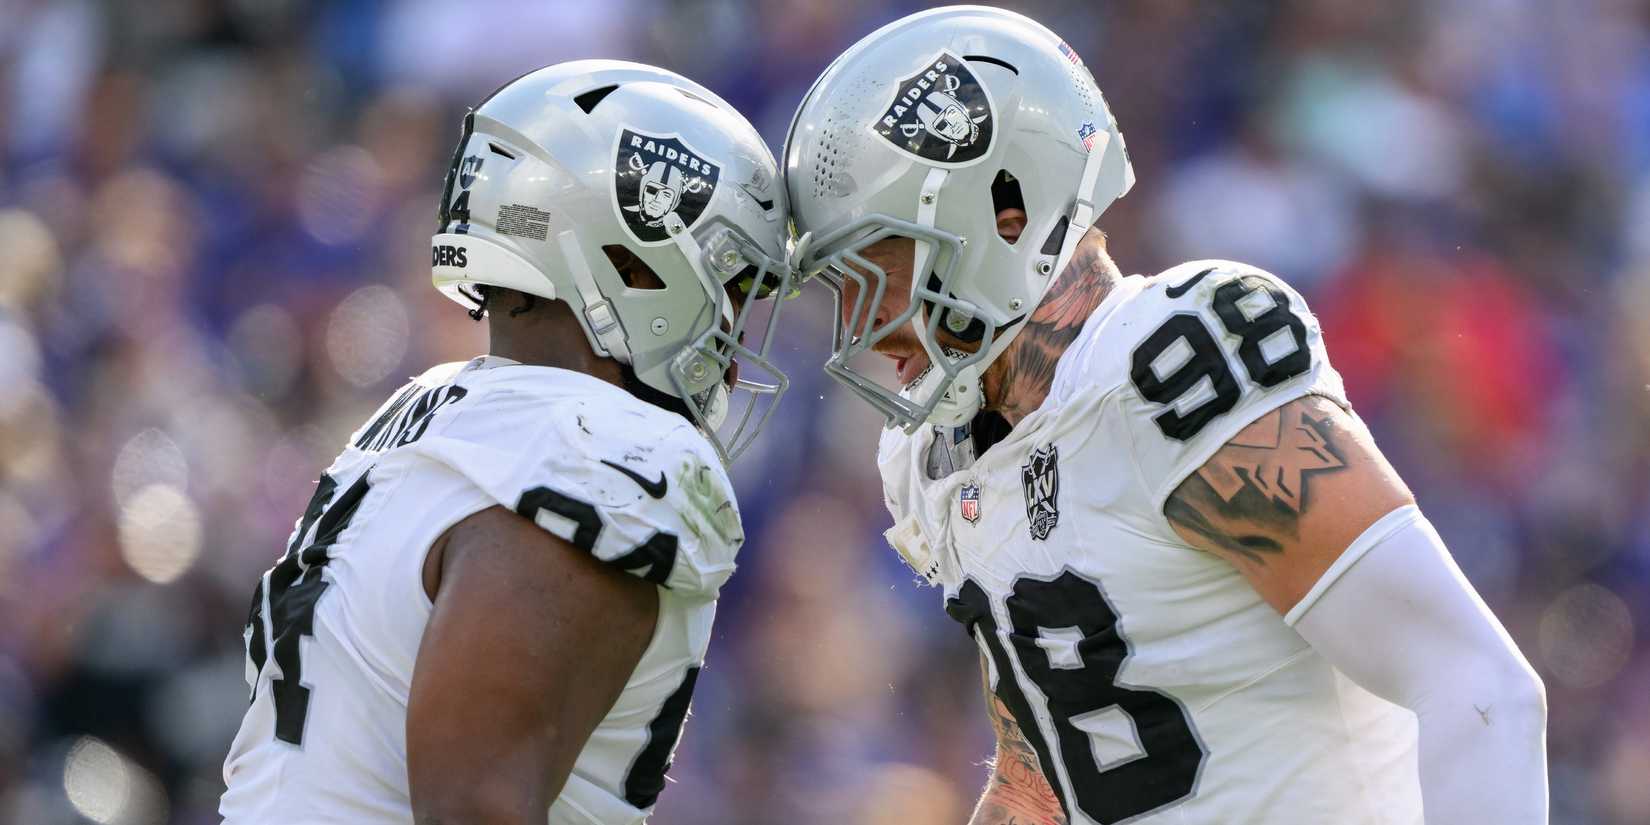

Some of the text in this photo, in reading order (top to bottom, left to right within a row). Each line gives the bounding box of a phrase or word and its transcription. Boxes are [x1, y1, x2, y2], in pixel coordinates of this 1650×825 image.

[882, 61, 947, 128] RAIDERS
[630, 135, 711, 176] RAIDERS
[1130, 275, 1311, 442] 98
